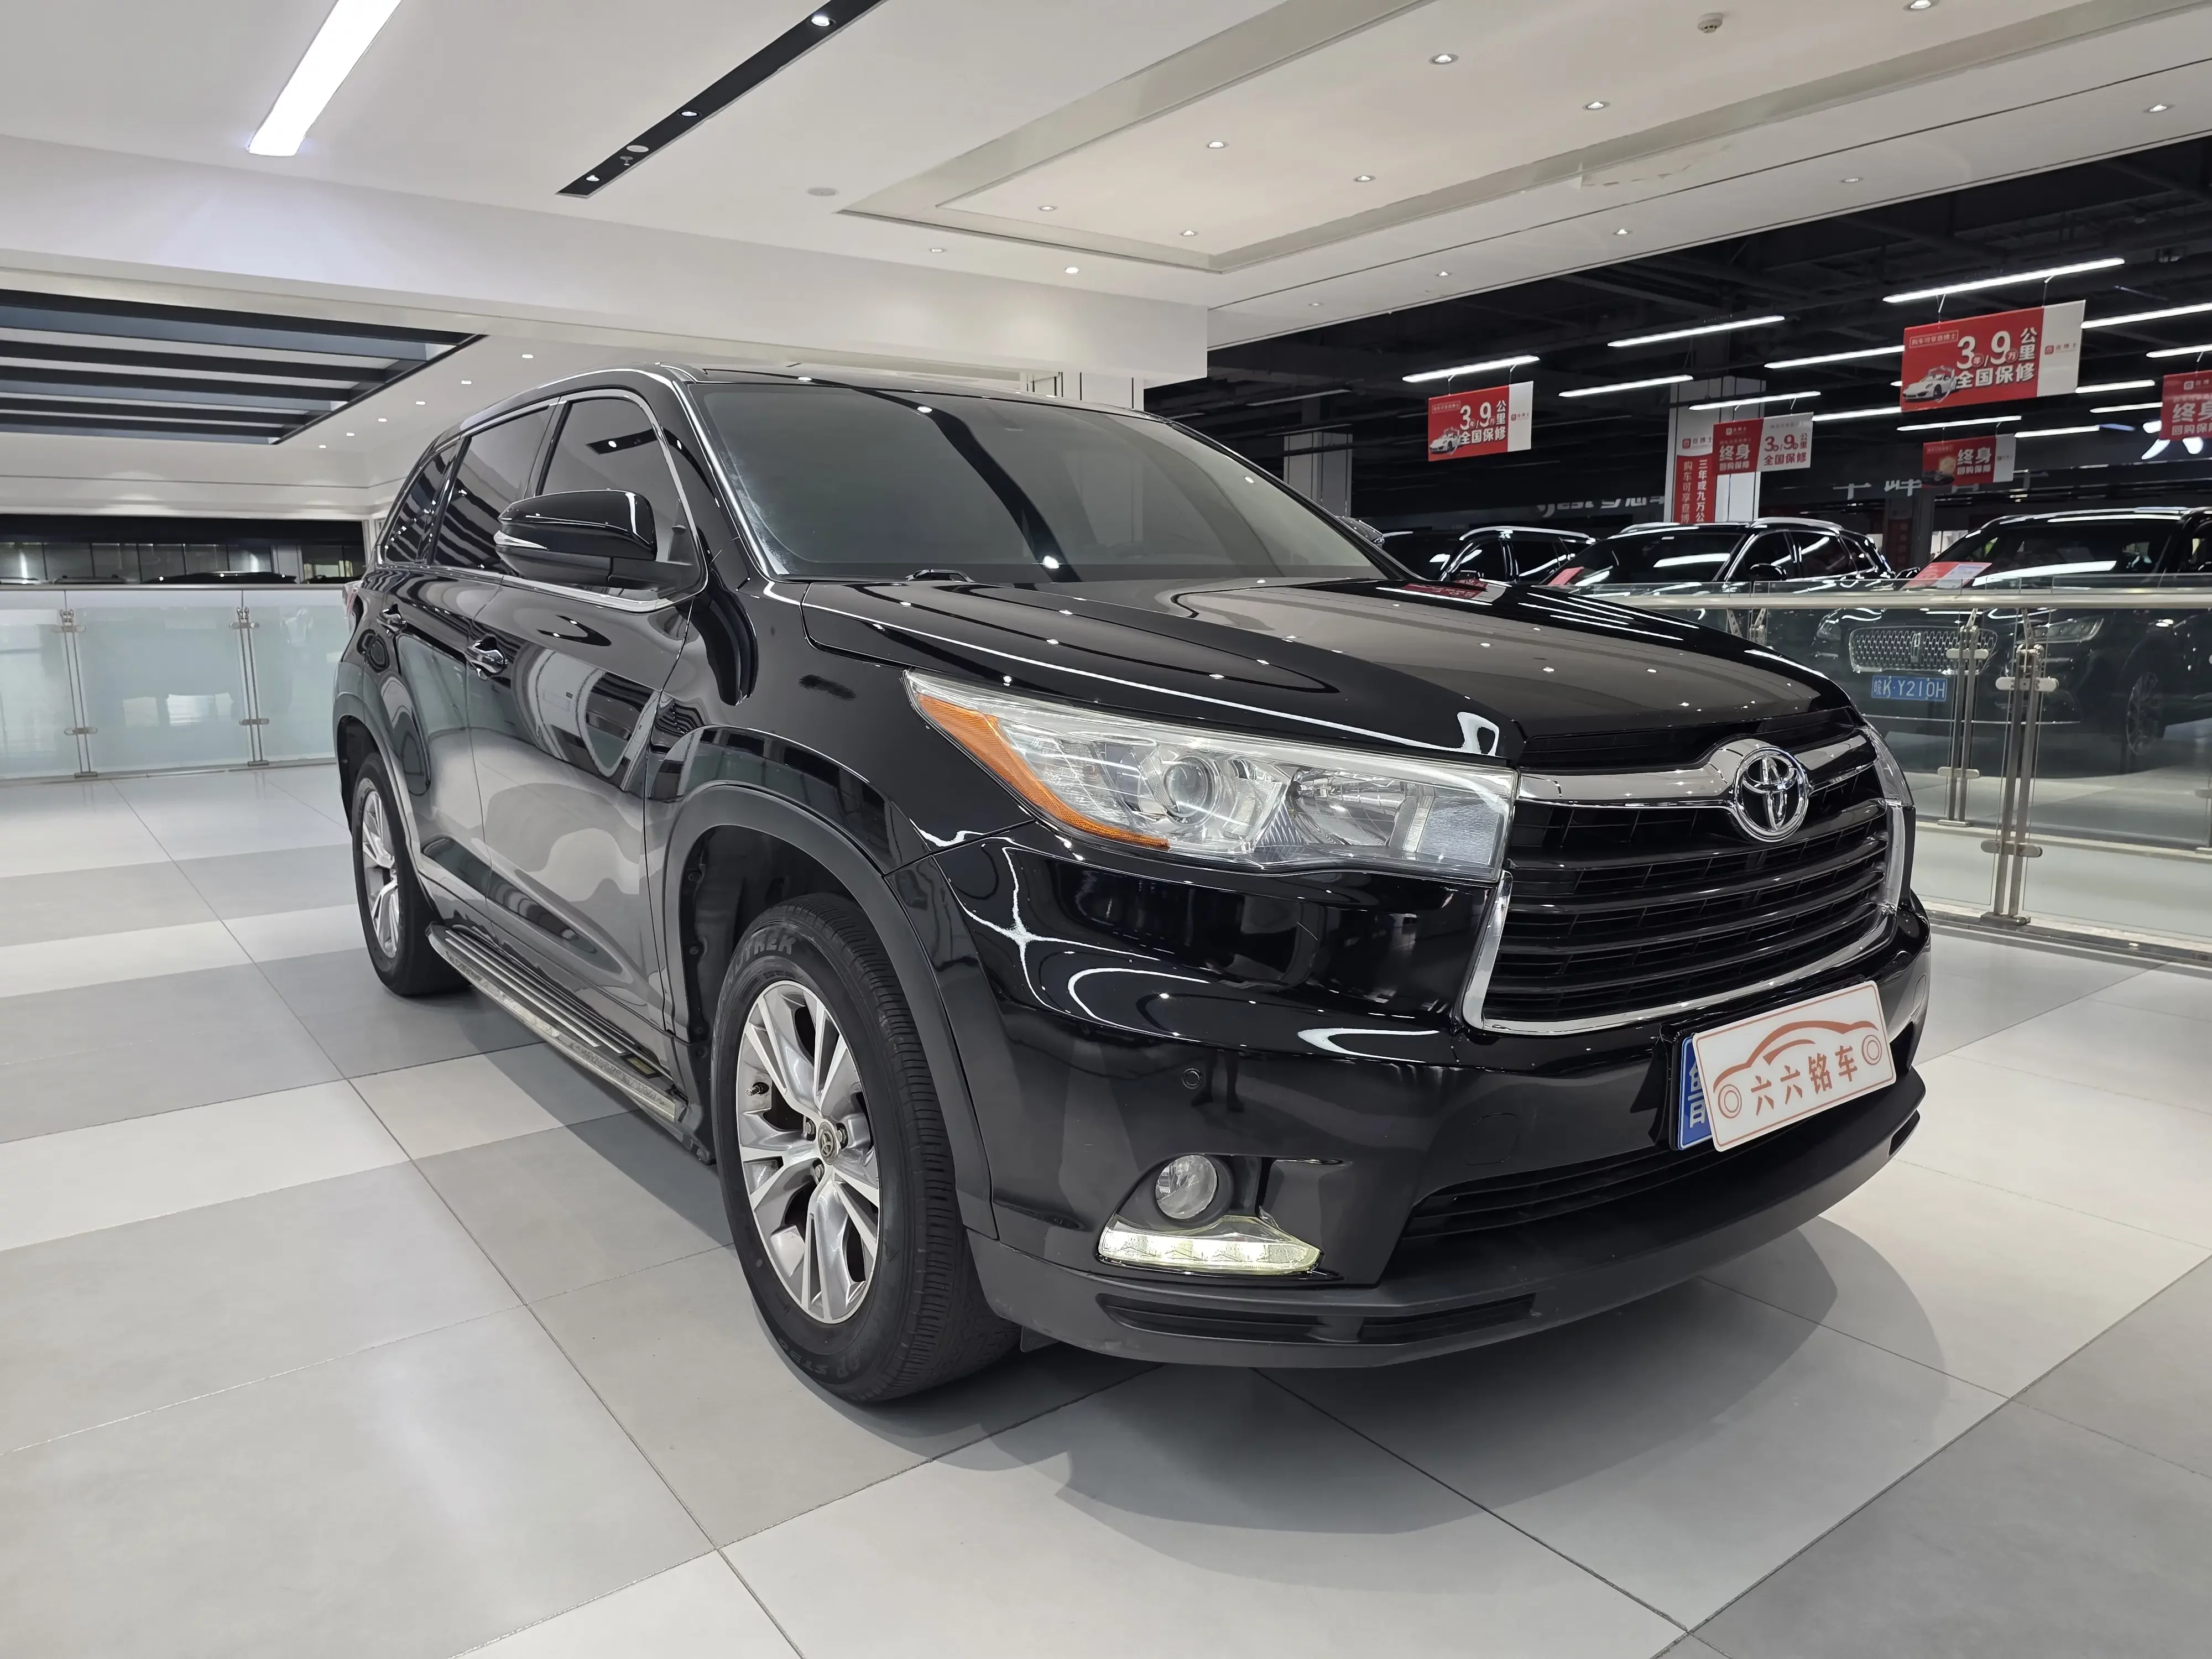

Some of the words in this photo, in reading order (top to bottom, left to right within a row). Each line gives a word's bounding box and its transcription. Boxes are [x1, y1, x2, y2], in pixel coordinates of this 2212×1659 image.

[1956, 362, 2036, 389] 全国保修
[1460, 426, 1506, 445] 全国保修
[1719, 444, 1751, 461] 终身
[1763, 452, 1807, 466] 全国保修
[1957, 447, 1992, 465] 终身
[1750, 1045, 1858, 1117] 六六铭车
